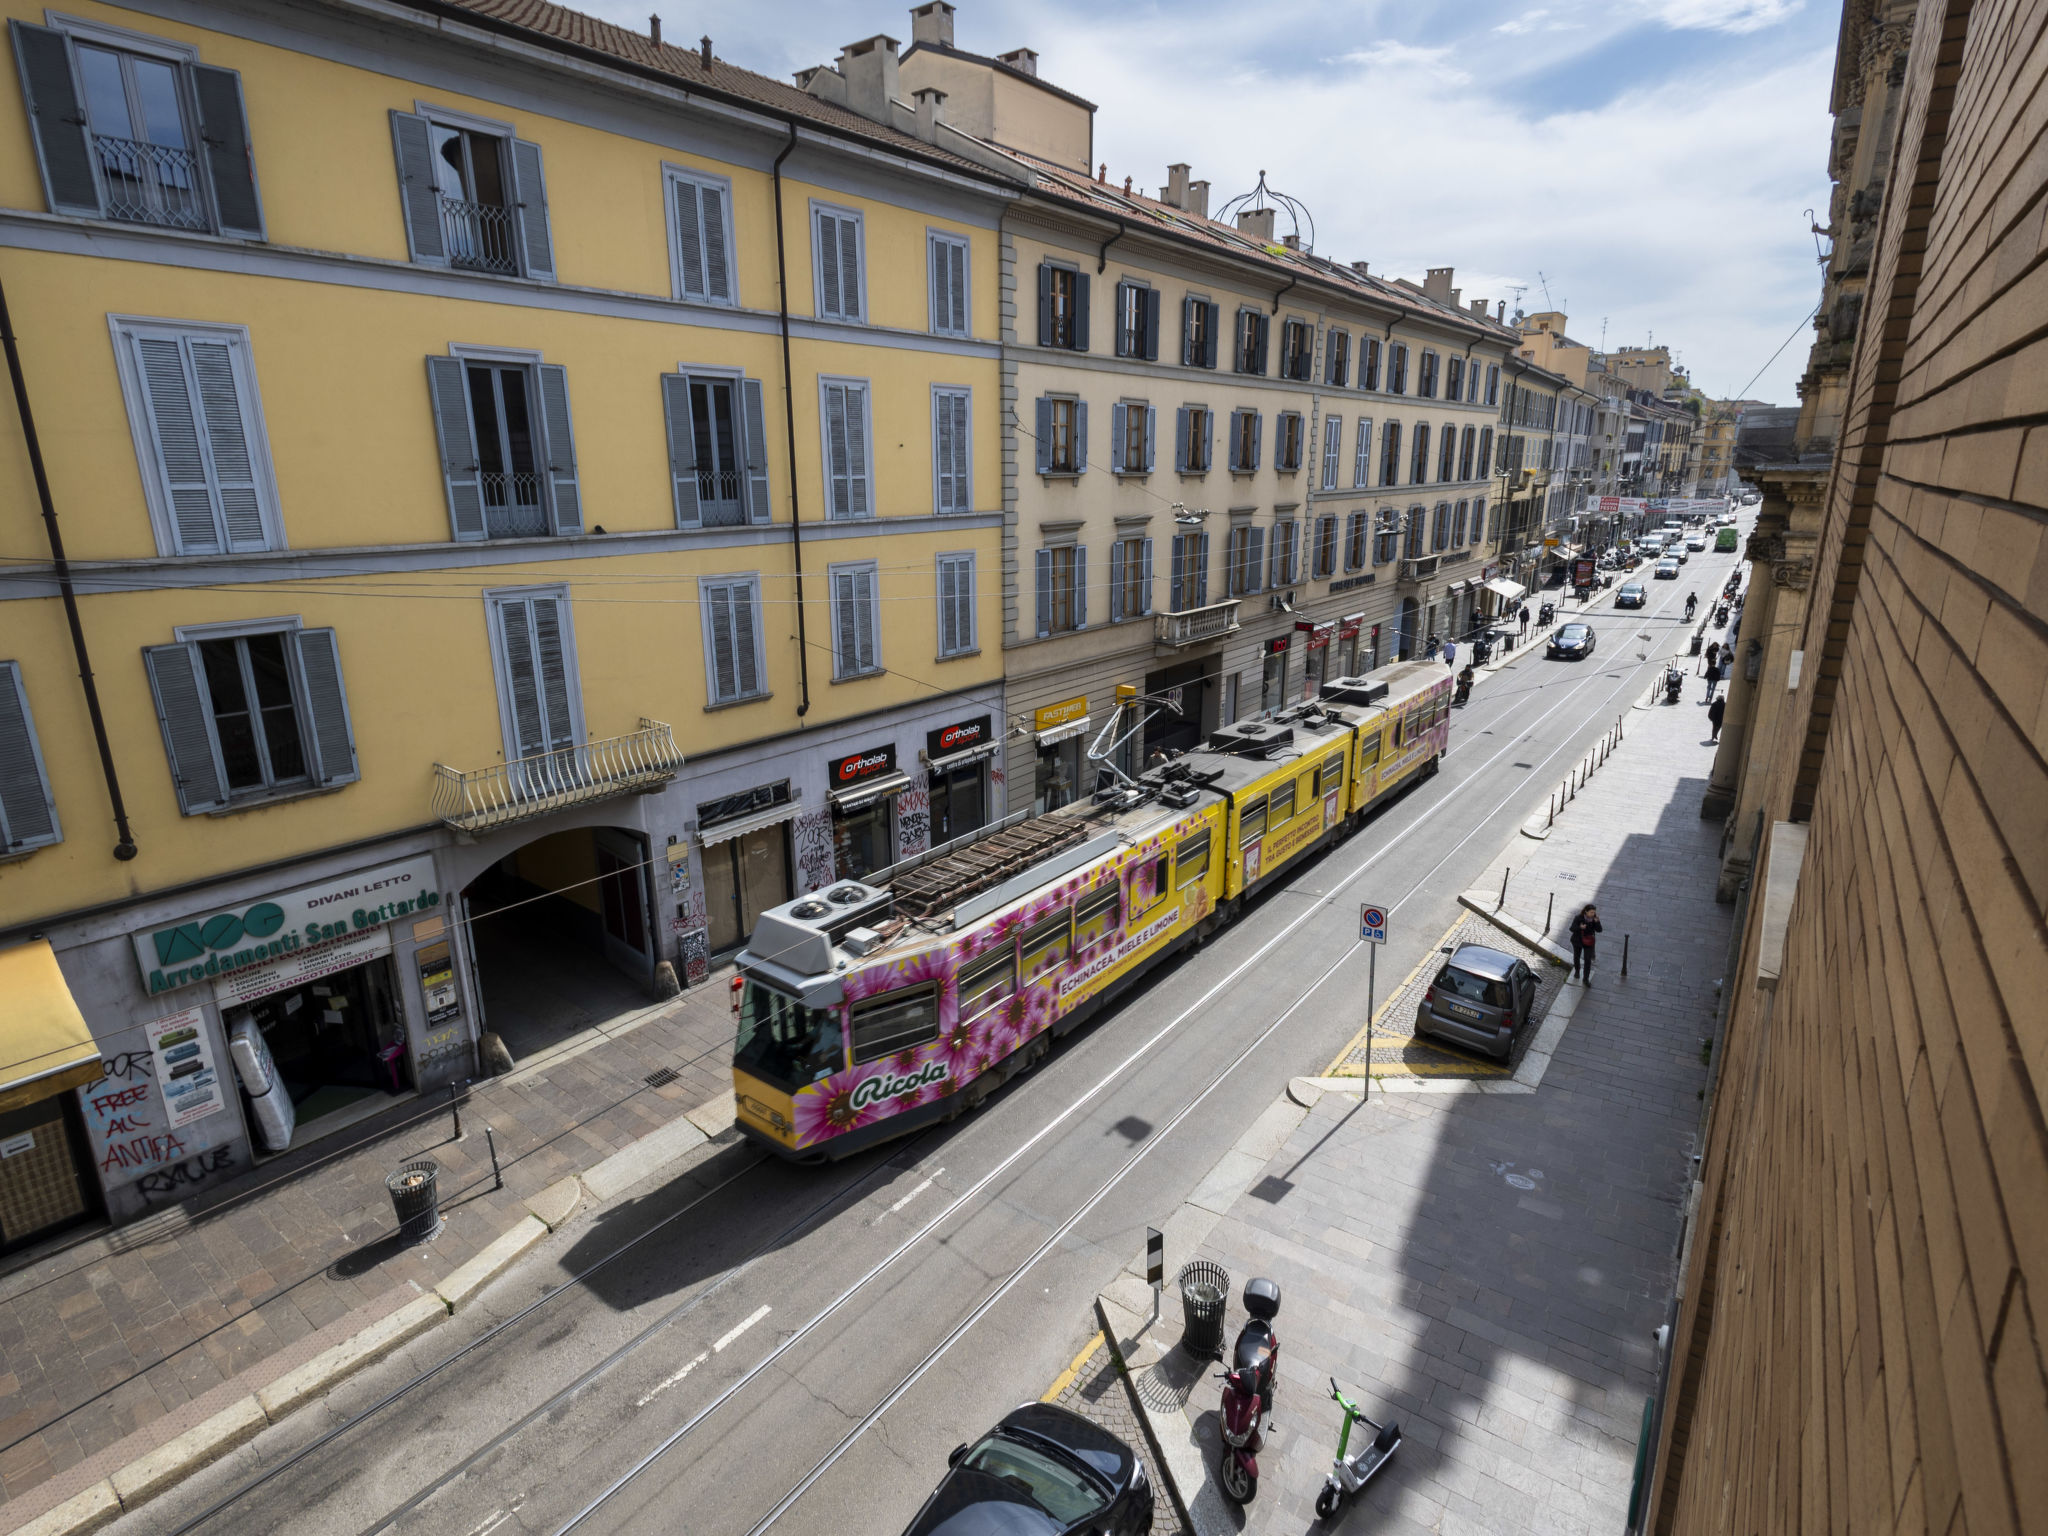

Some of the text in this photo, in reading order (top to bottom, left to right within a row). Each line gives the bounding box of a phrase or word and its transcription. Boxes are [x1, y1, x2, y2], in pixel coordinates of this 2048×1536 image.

[1043, 702, 1082, 720] FASTWEB
[945, 724, 980, 742] ortholab
[957, 732, 979, 744] sport
[845, 753, 887, 772] ortholab
[859, 761, 886, 776] sport
[1276, 842, 1291, 857] GUSTO
[307, 873, 412, 909] DIVANI LETTO
[150, 929, 300, 994] Arredamenti
[305, 920, 348, 944] San
[352, 889, 439, 929] Gottardo
[1062, 954, 1116, 995] ECHINACEA,
[1117, 934, 1141, 958] MIELE
[1143, 931, 1149, 941] E
[1150, 910, 1178, 937] LIMONE
[240, 953, 375, 1000] WWW.SANGOTTARDO.IT
[850, 1060, 949, 1109] Ricola
[91, 1084, 149, 1117] FREE
[106, 1115, 151, 1138] ALL
[101, 1133, 185, 1172] ANTIFA
